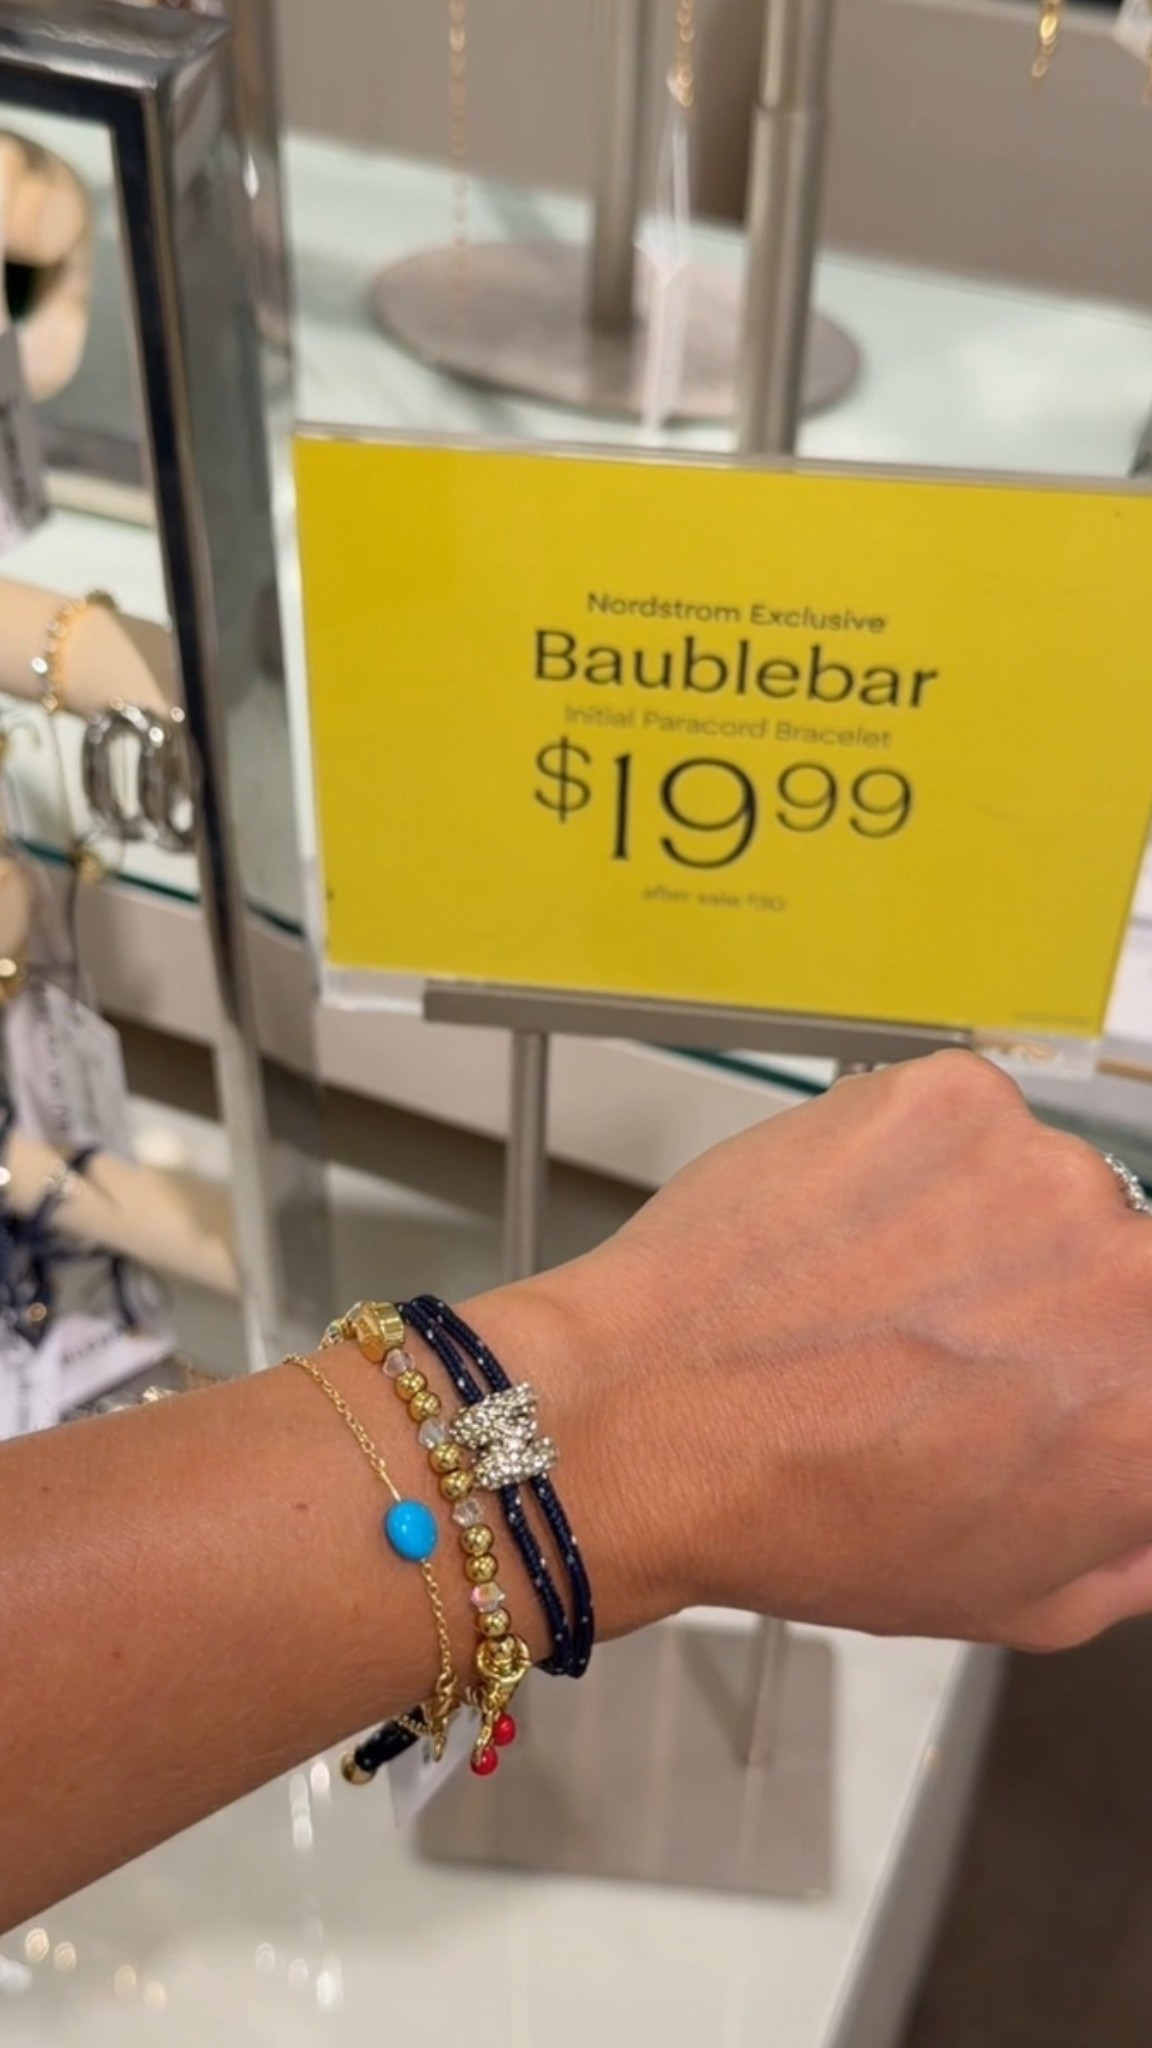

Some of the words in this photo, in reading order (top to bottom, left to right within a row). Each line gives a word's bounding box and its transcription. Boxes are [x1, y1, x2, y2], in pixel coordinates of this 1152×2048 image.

[586, 592, 741, 624] Nordstrom
[749, 603, 887, 634] Exclusive
[533, 629, 940, 709] Baublebar
[563, 704, 635, 729] Initial
[642, 710, 768, 740] Paracord
[776, 721, 892, 749] Bracelet
